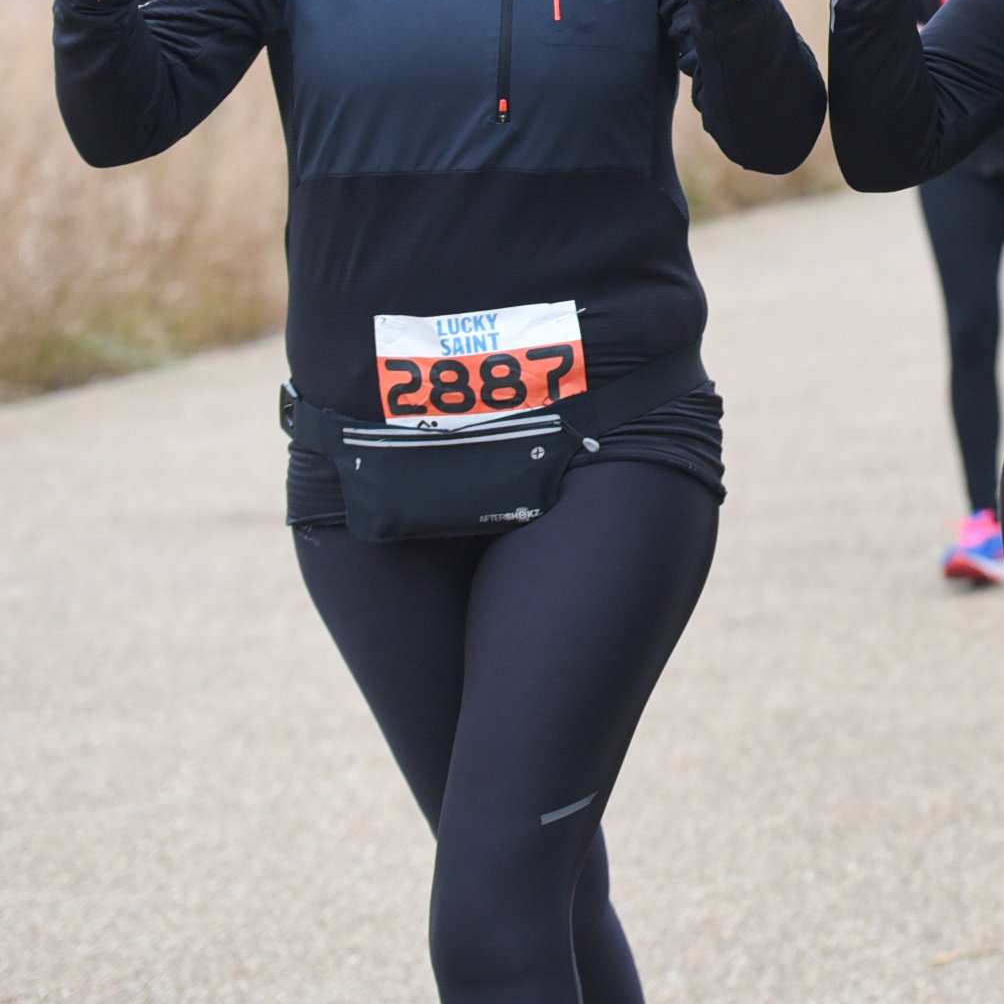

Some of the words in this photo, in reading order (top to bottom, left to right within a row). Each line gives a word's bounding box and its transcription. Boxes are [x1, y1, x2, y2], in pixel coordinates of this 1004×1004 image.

[437, 313, 498, 336] LUCKY
[439, 332, 500, 357] SAINT
[384, 344, 575, 416] 2887
